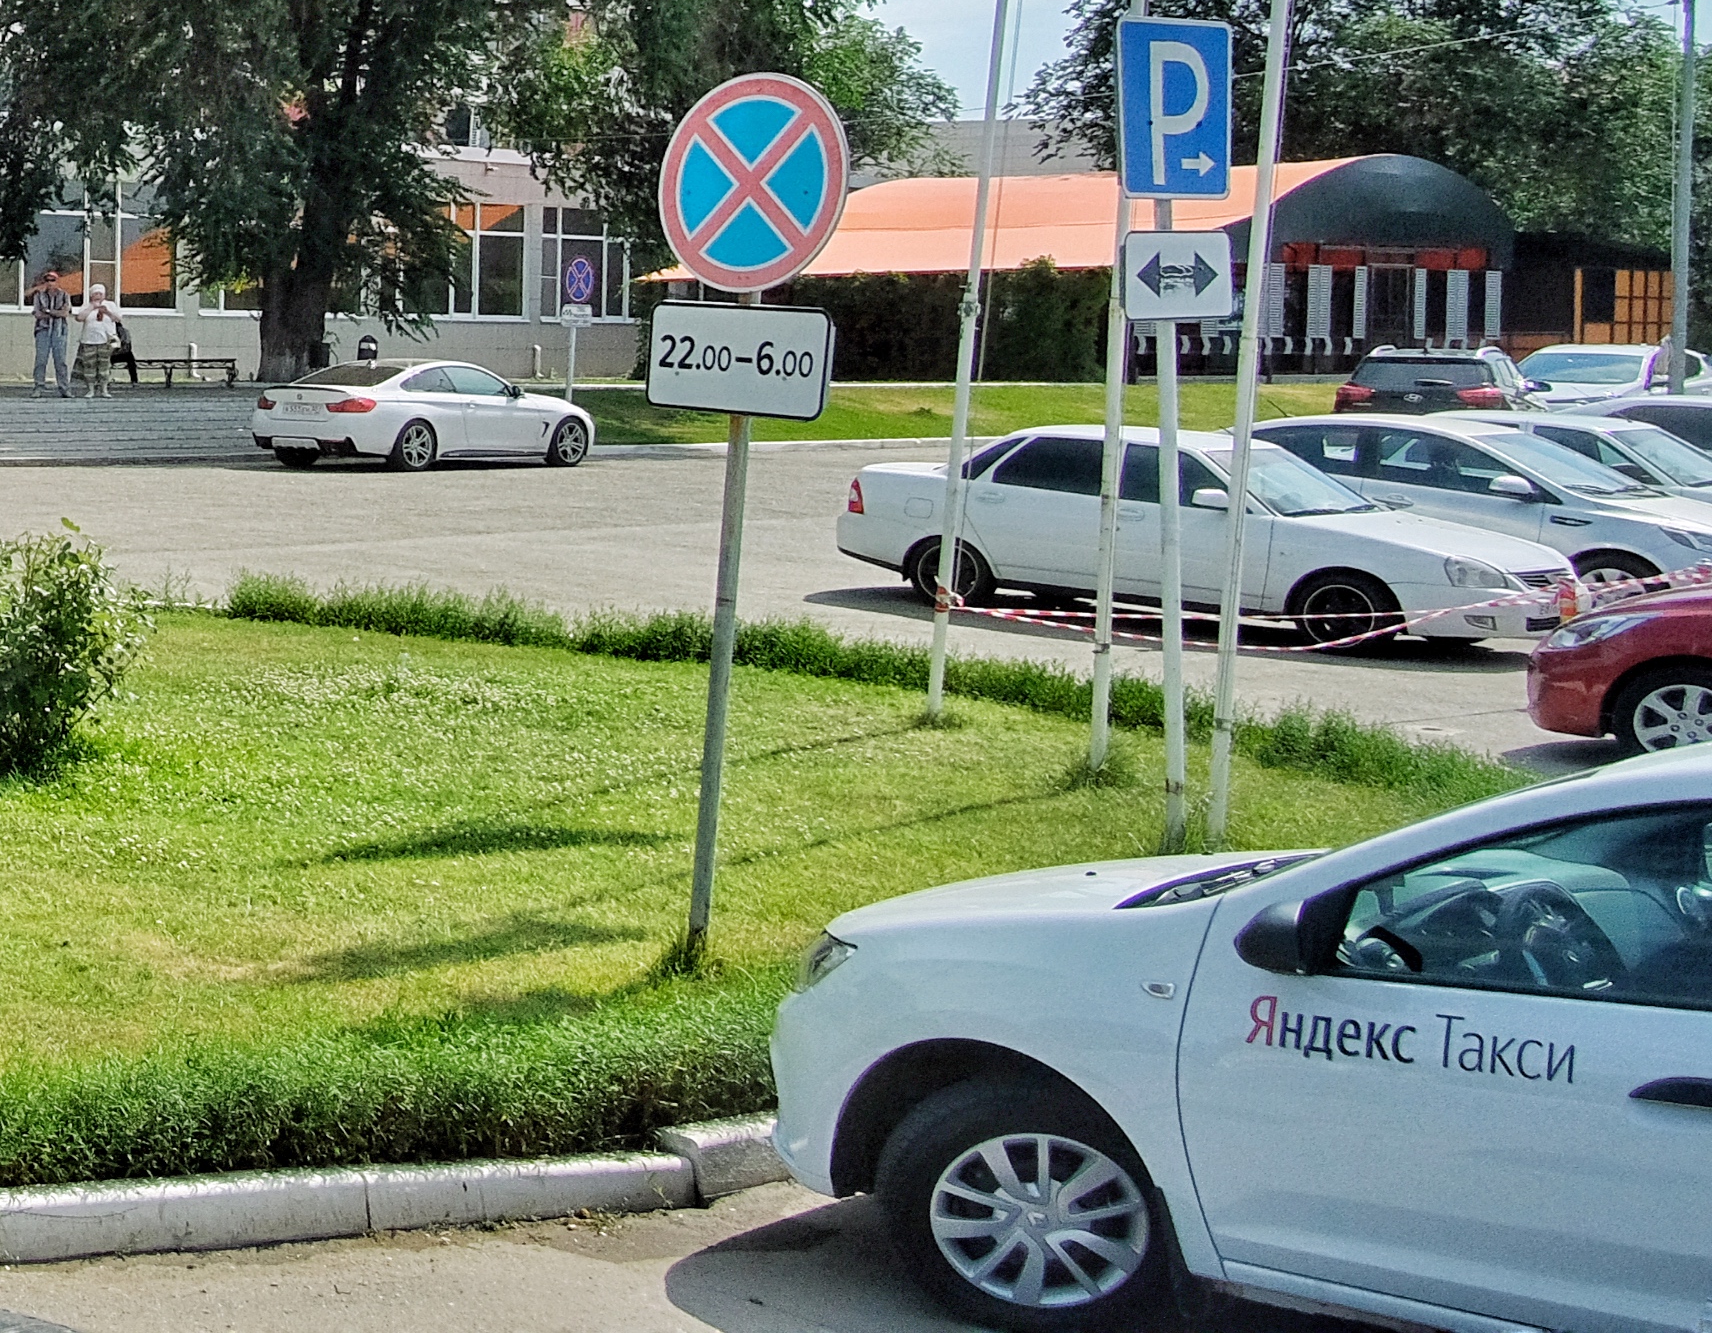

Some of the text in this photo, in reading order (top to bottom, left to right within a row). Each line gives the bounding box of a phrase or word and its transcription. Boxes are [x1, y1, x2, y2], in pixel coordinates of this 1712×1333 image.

[1150, 41, 1209, 185] P
[1245, 995, 1576, 1084] Яндекс Такси
